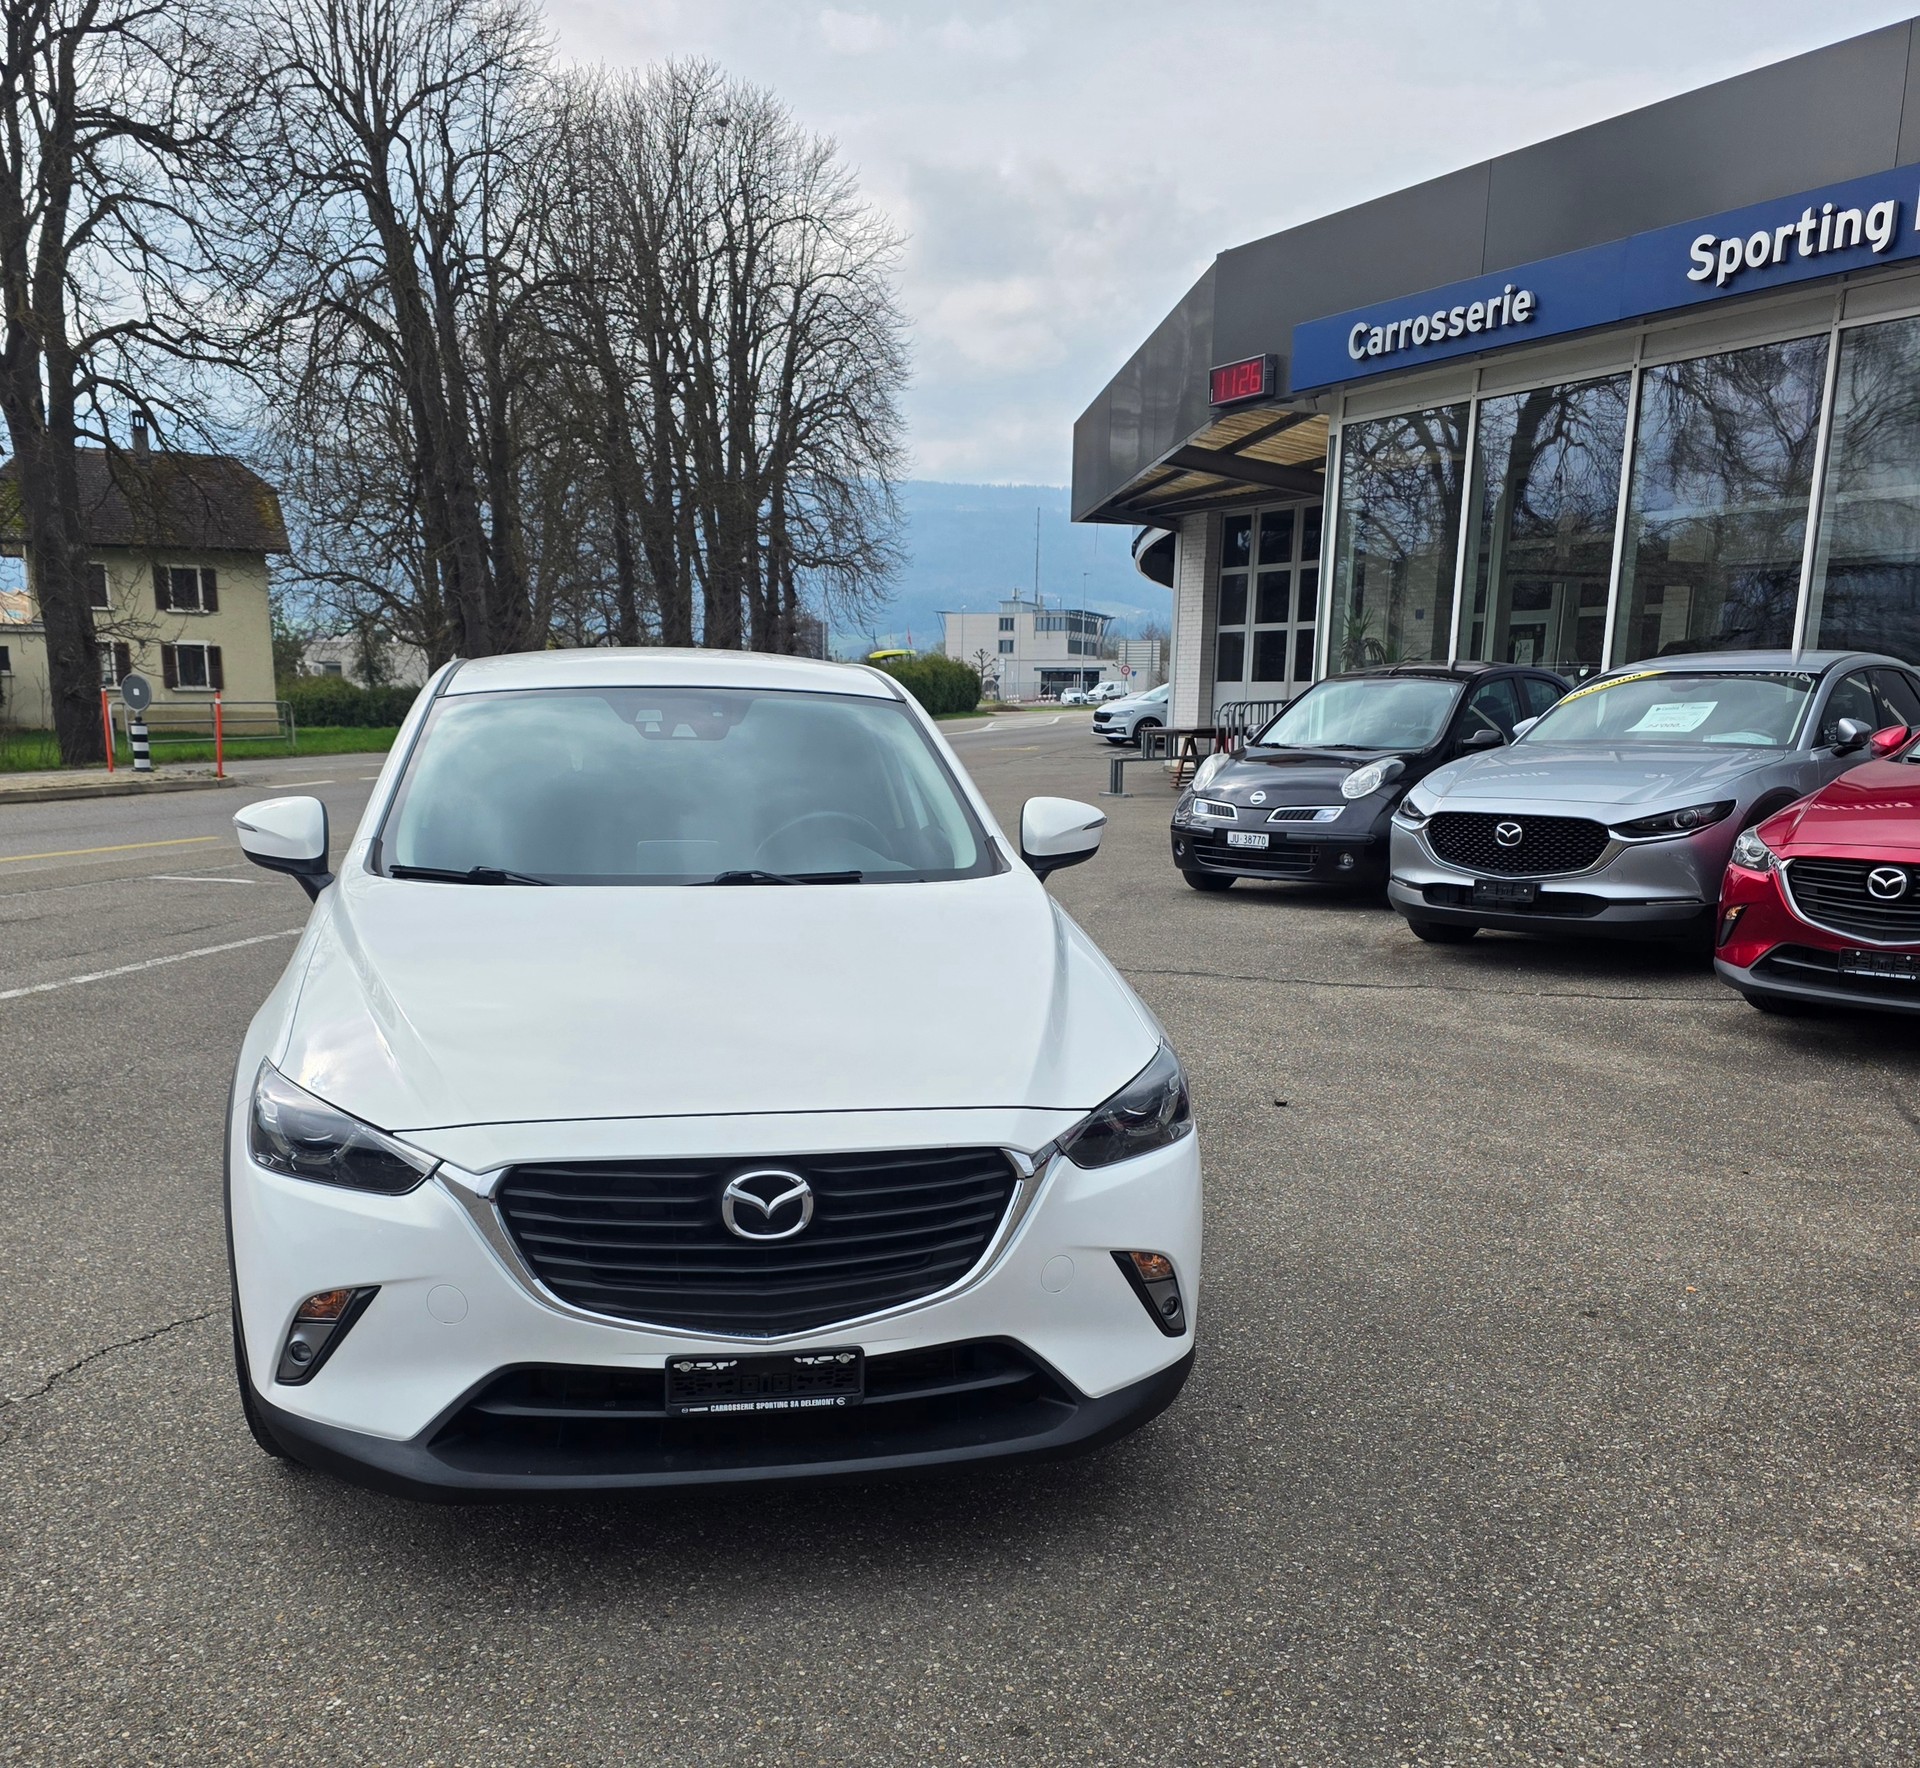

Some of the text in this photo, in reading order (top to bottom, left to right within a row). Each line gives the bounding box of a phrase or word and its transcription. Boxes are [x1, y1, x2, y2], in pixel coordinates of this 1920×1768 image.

[1348, 284, 1533, 360] Carrosserie
[1686, 199, 1897, 287] Sporting
[710, 1402, 755, 1412] CARROSSERIE
[756, 1400, 789, 1411] SPORTING
[790, 1400, 800, 1408] SA
[800, 1398, 835, 1407] DELEMONT
